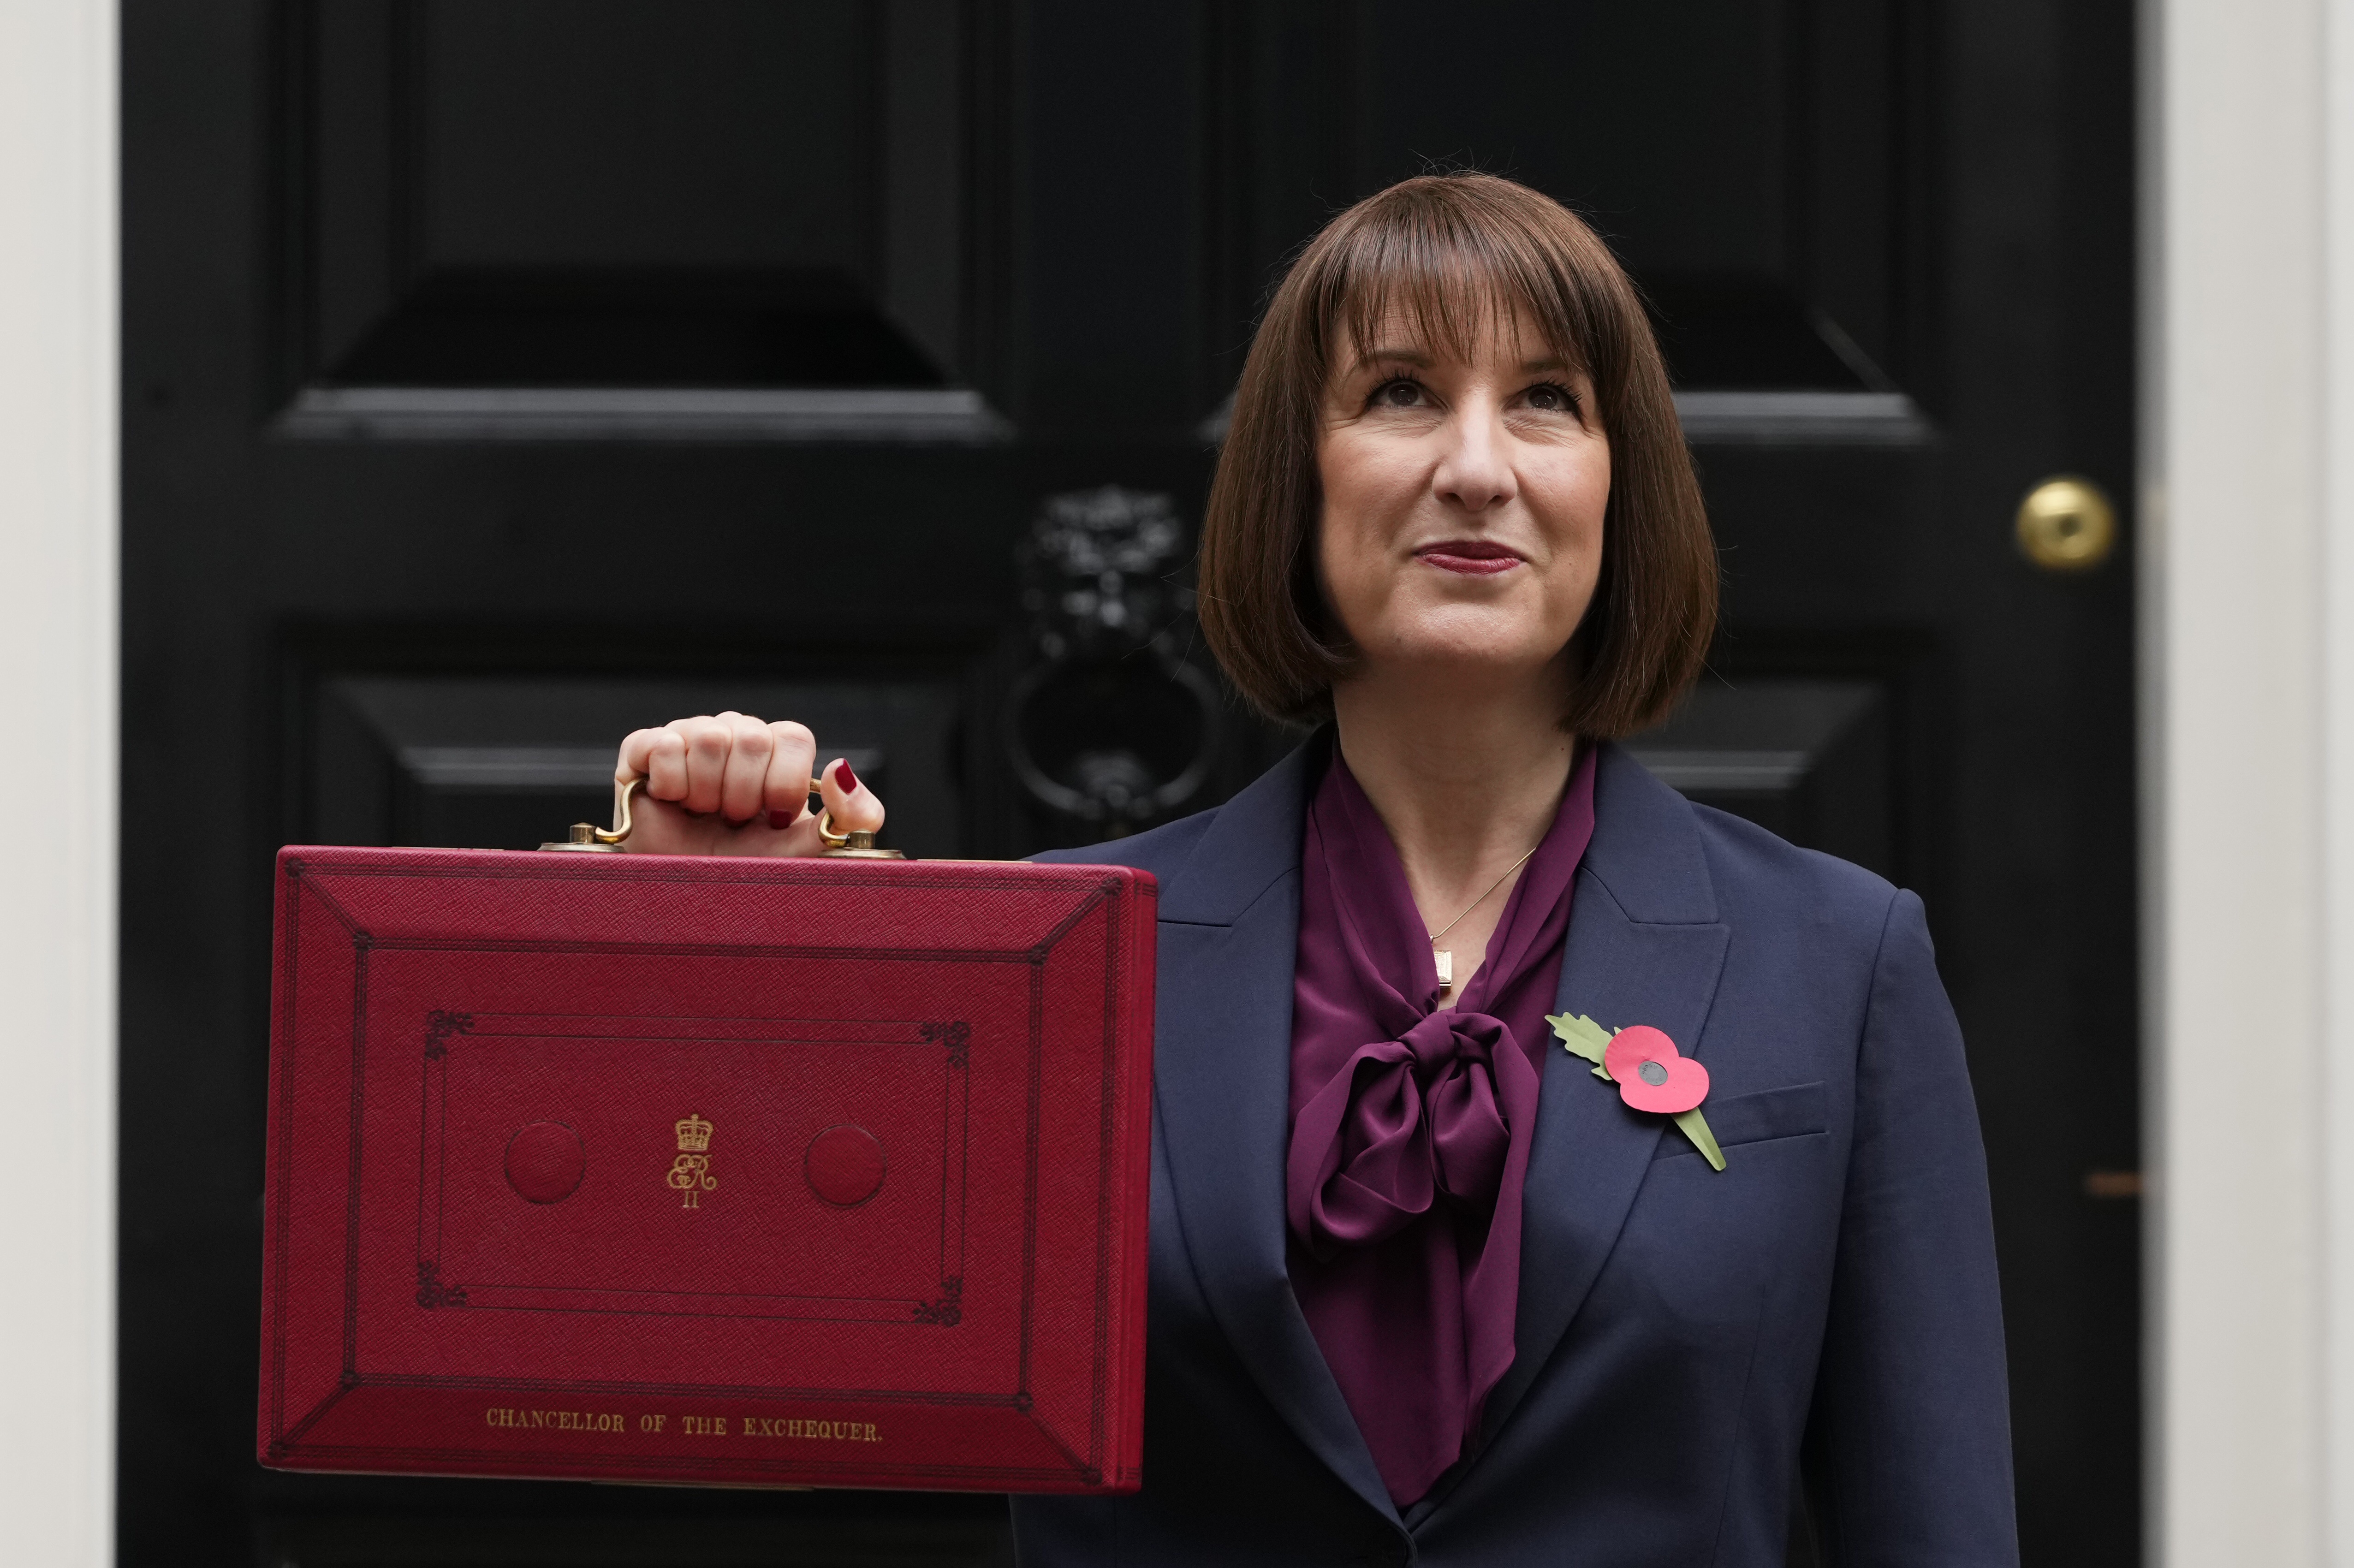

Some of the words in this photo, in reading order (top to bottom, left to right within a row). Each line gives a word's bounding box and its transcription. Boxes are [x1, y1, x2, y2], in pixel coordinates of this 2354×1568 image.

[487, 1408, 624, 1431] CHANCELLOR
[641, 1414, 666, 1431] OF
[683, 1416, 726, 1435] THE
[743, 1417, 882, 1442] EXCHEQUER.
